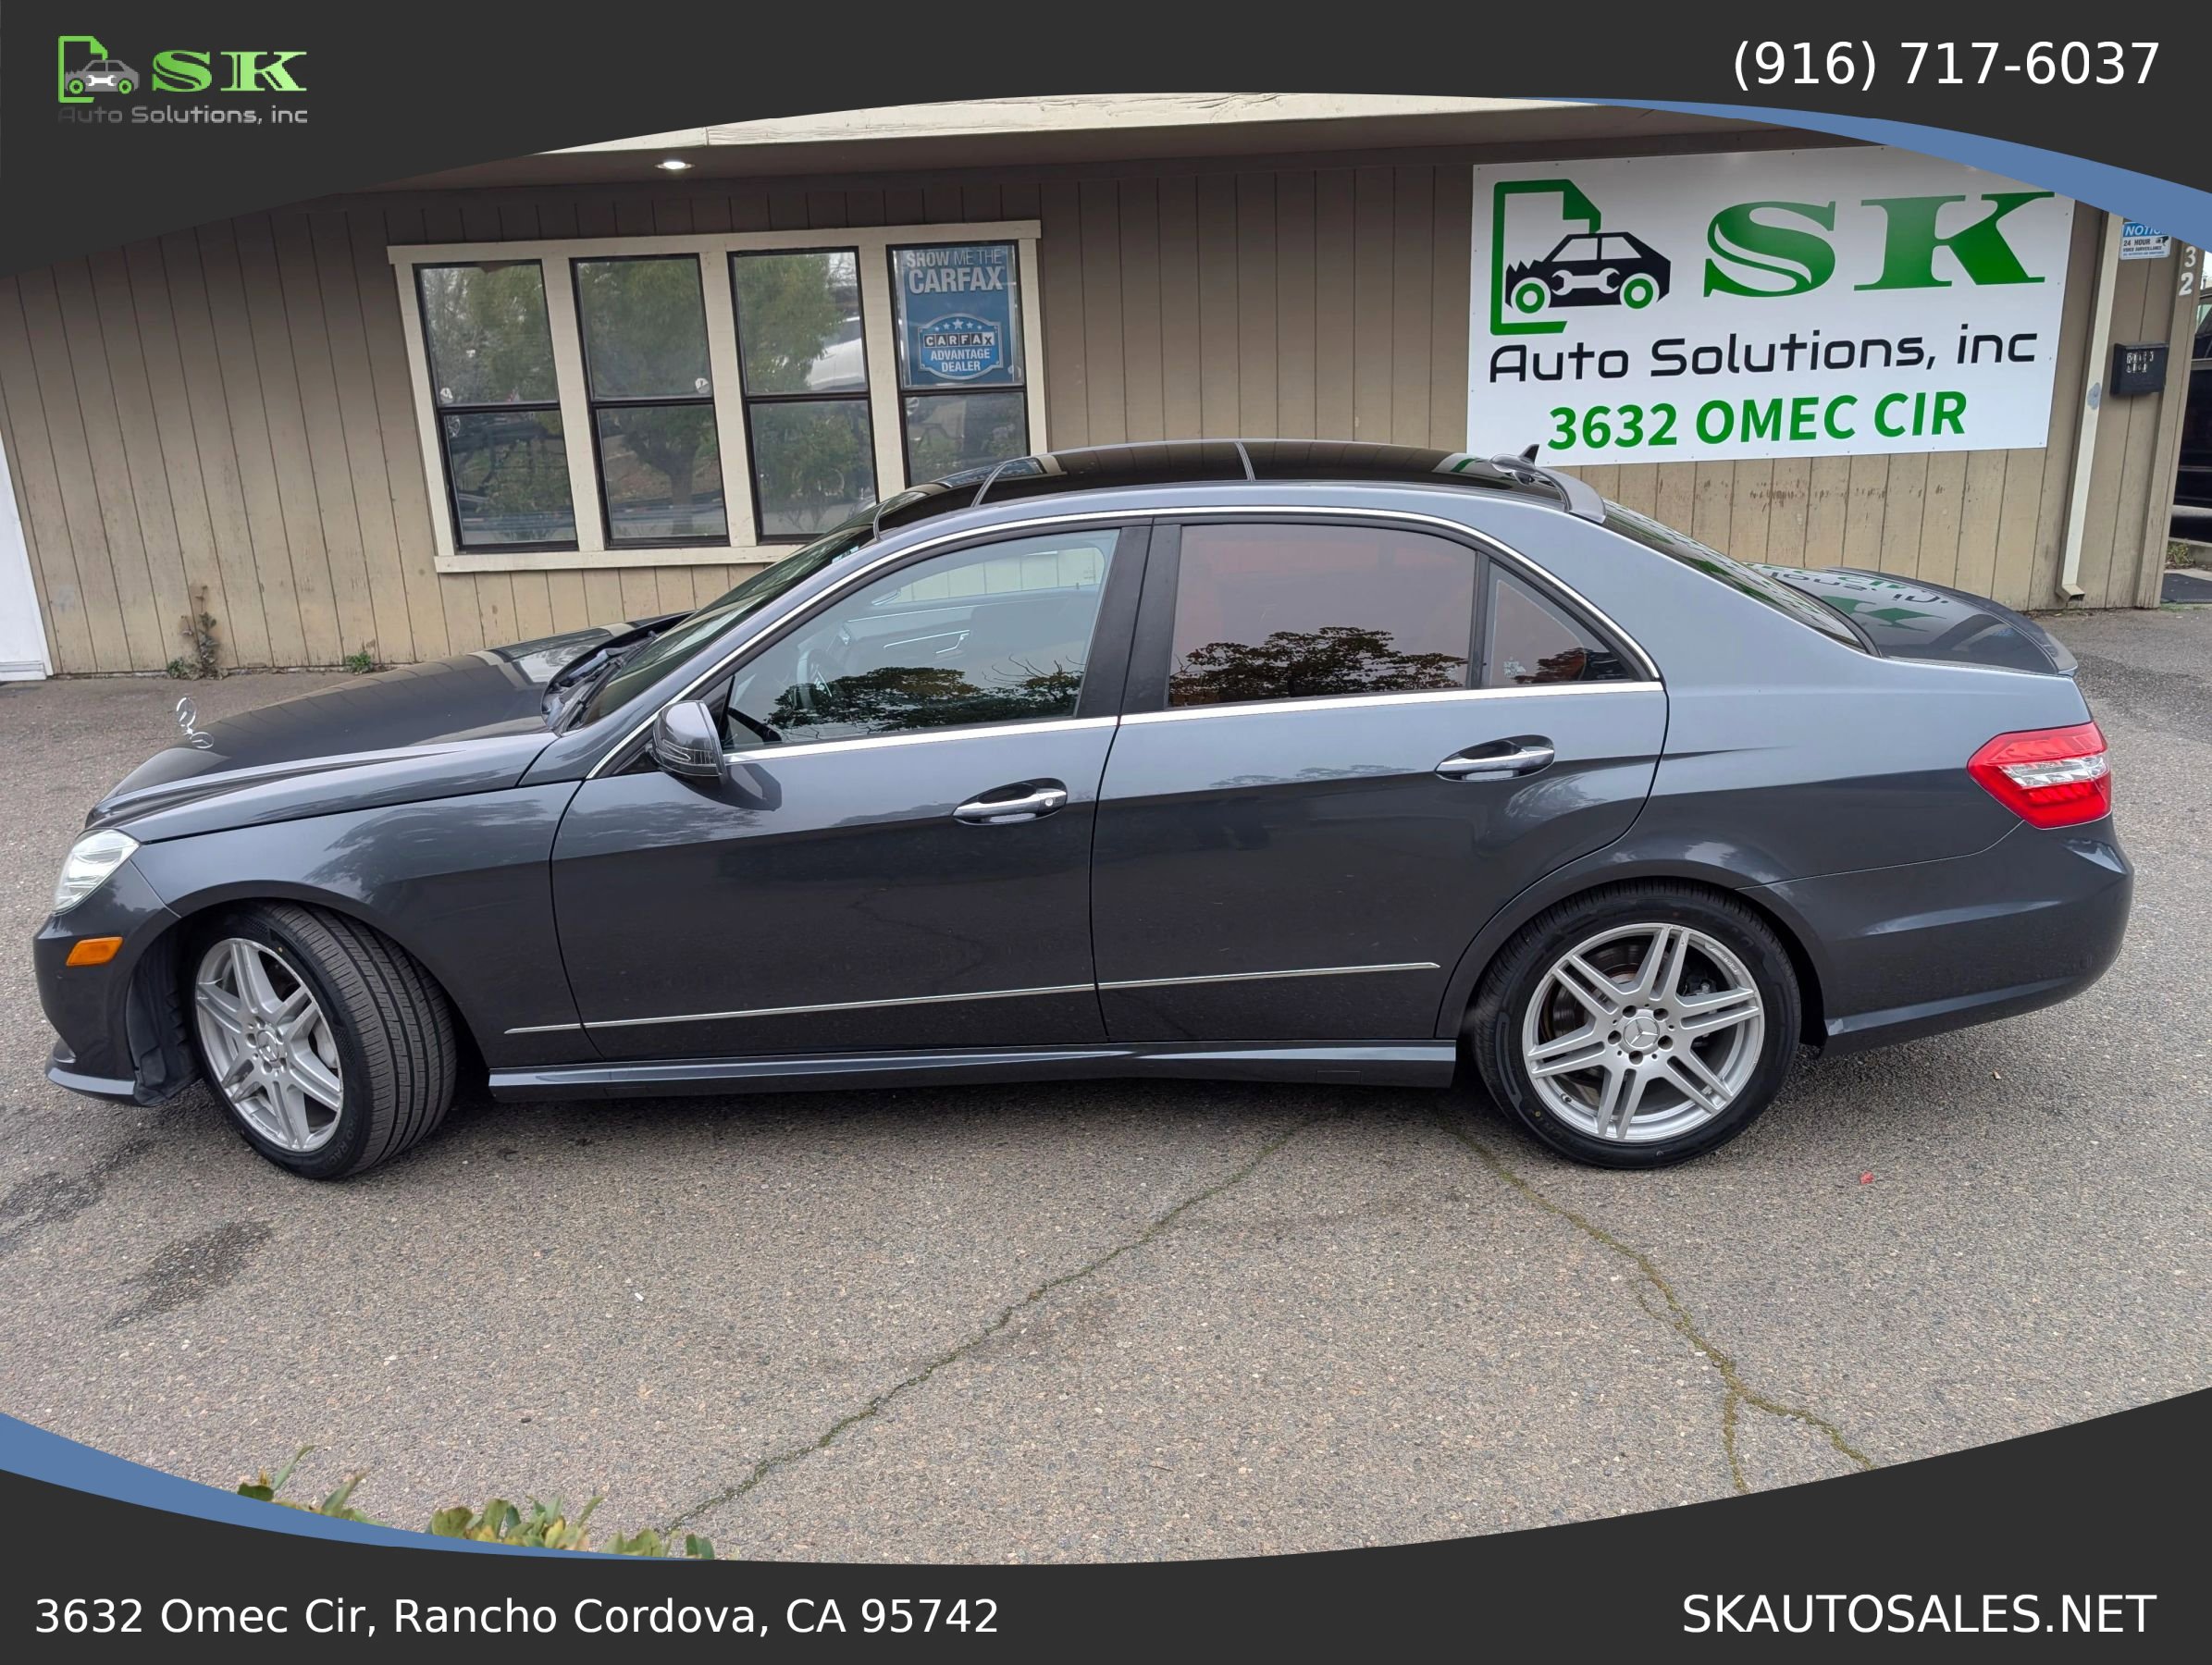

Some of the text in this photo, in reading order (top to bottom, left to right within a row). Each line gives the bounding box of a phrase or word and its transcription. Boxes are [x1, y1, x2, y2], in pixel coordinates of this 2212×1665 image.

[2125, 225, 2161, 236] NOTI
[1704, 191, 2055, 298] SK
[907, 249, 1003, 267] SHOW ME THE
[908, 265, 1004, 294] CARFAX
[925, 334, 994, 347] CARFAX
[931, 349, 990, 361] ADVANTAGE
[1490, 324, 2038, 383] Auto Solutions, inc
[941, 361, 981, 373] DEALER
[1548, 390, 1968, 450] 3632 OMEC CIR
